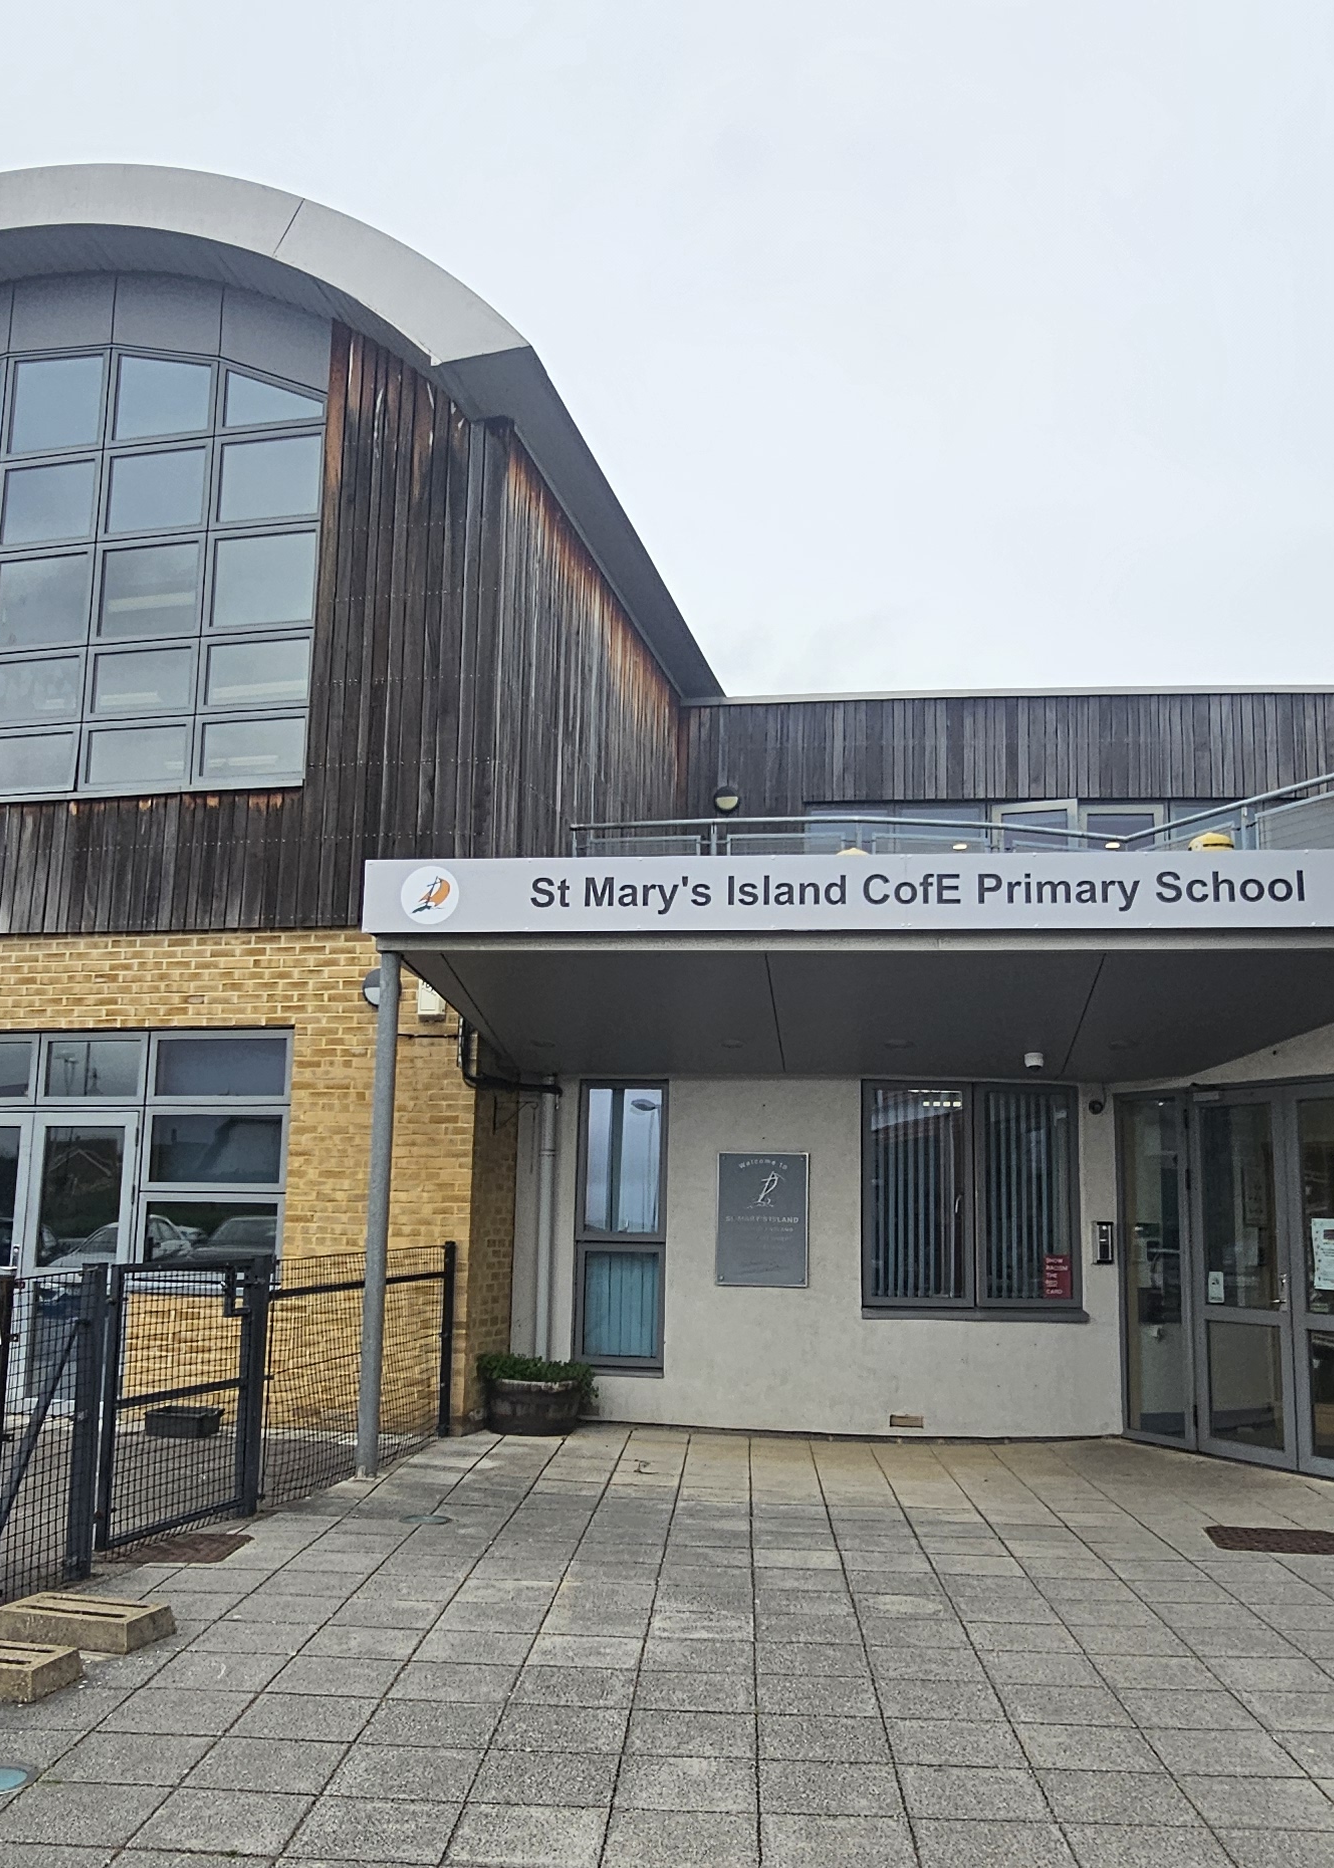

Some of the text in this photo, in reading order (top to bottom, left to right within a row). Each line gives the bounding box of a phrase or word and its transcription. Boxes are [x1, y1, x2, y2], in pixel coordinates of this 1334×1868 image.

[529, 869, 1307, 916] St Mary's Island CofE Primary School
